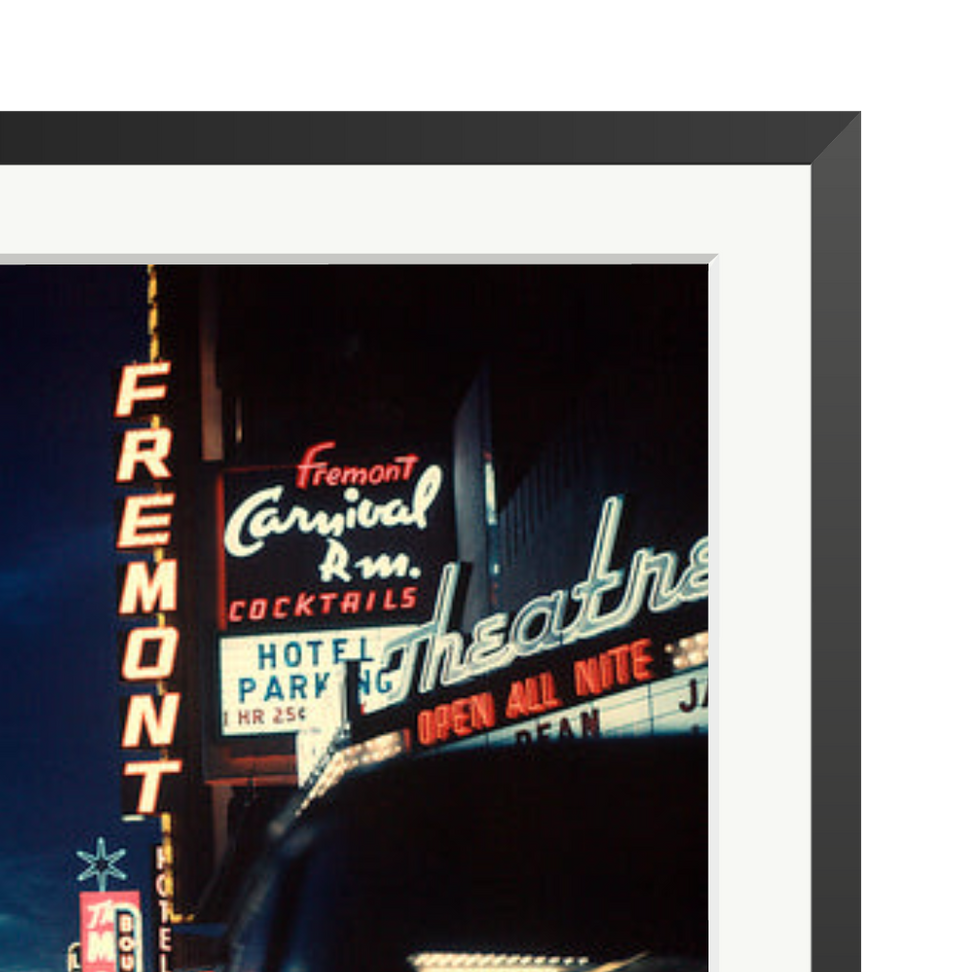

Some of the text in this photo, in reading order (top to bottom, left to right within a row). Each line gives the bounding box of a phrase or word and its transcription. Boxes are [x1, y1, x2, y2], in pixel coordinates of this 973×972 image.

[224, 464, 443, 557] Carnival
[318, 537, 421, 582] Rm.
[115, 362, 182, 814] FREMONT
[228, 587, 418, 623] COCKTAILS
[383, 494, 708, 704] Theatre
[257, 637, 374, 670] HOTEL
[238, 670, 393, 703] PARKNG
[417, 637, 655, 746] OPEN ALL NITE
[238, 707, 265, 725] HR
